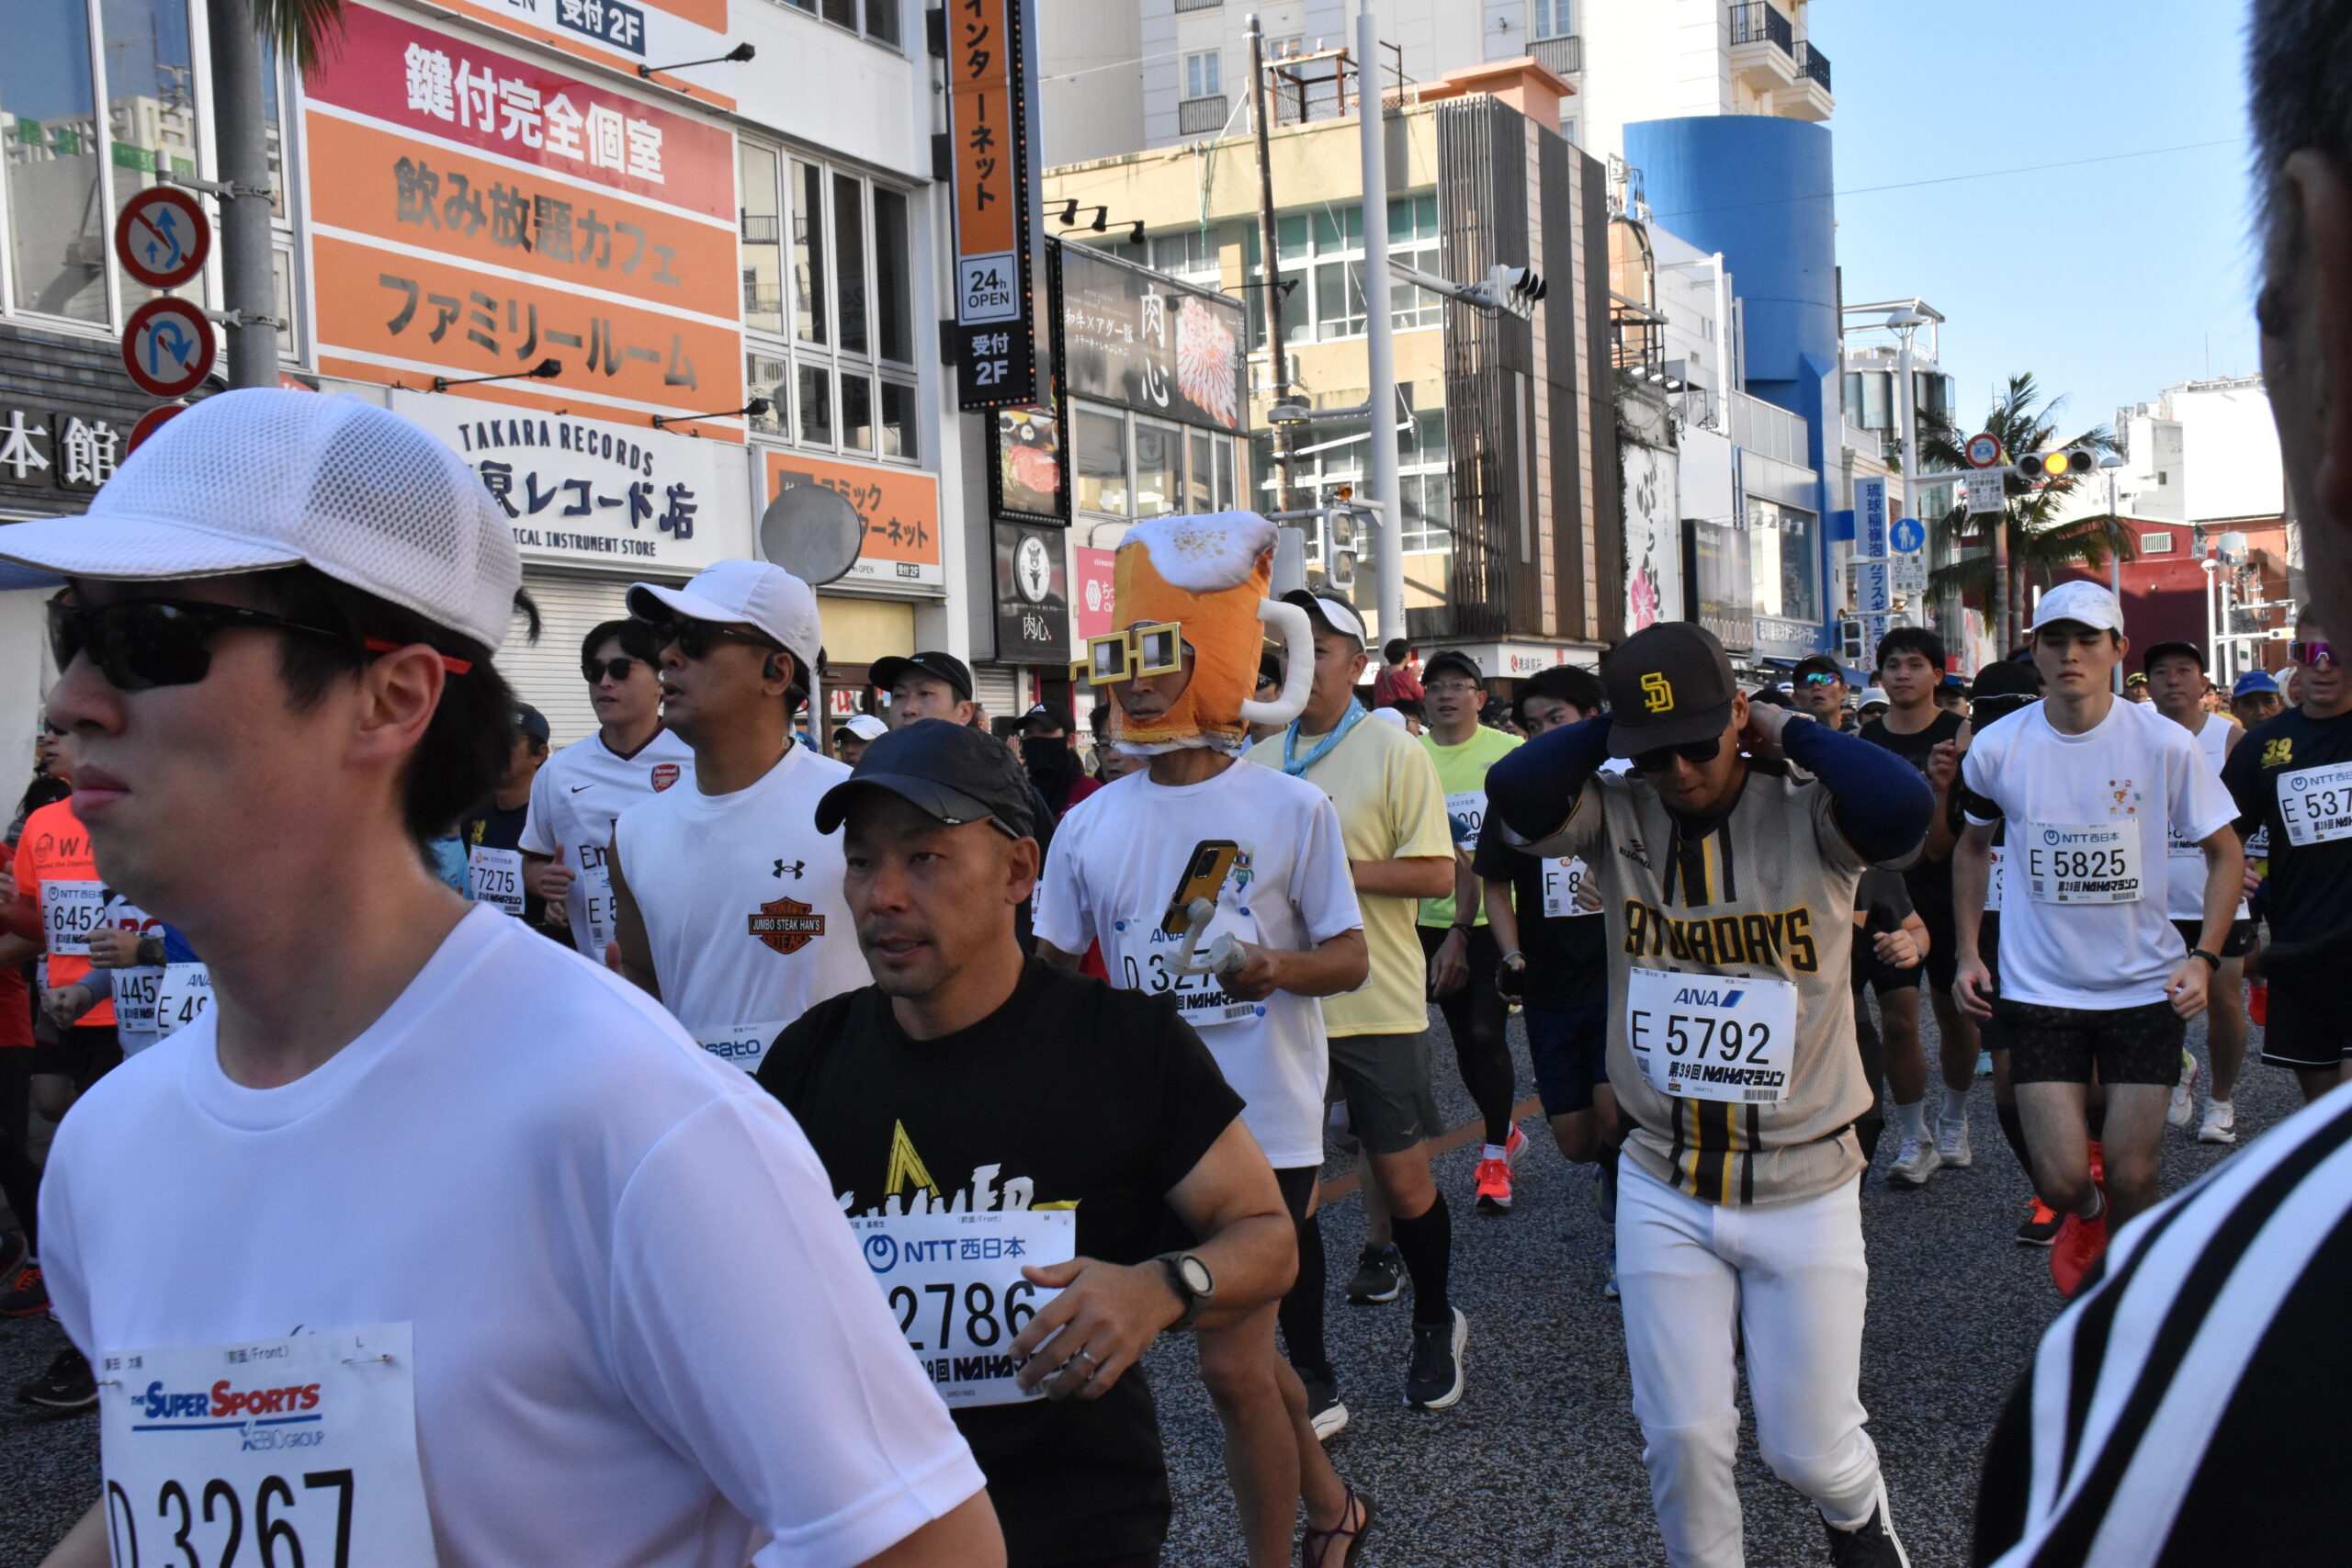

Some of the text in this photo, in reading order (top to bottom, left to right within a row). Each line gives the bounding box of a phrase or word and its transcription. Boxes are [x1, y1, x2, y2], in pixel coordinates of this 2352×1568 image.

[609, 8, 639, 46] 2F
[404, 42, 664, 185] 鍵付完全個室
[393, 155, 680, 287] 飲み放題カフェ
[968, 291, 1010, 308] OPEN
[379, 273, 698, 392] ファミリールーム
[971, 333, 1010, 356] 受付
[1140, 283, 1170, 408] 肉心
[976, 359, 1009, 386] 2F
[0, 410, 119, 485] 本館
[458, 418, 654, 478] TAKARA RECORDS
[514, 527, 656, 556] ICAL INSTRUMENT STORE
[859, 513, 929, 549] ターネット
[859, 565, 875, 574] OPEN
[910, 566, 919, 577] 2F
[1023, 613, 1049, 641] 肉心
[1640, 671, 1675, 714] SD
[2282, 798, 2299, 824] E
[2030, 848, 2126, 878] E 5825
[479, 868, 514, 893] 7275
[1545, 873, 1559, 896] F
[54, 906, 106, 931] 6452
[588, 897, 602, 924] E
[753, 919, 820, 931] JUMBO STEAK HAN'S
[1124, 955, 1140, 990] D
[121, 976, 164, 1005] 445
[1673, 987, 1719, 1008] ANA
[157, 996, 173, 1028] E
[706, 1039, 761, 1057] sato
[1632, 1010, 1771, 1066] E 5792
[905, 1236, 1026, 1264] NTT西日本
[888, 1280, 1036, 1350] 2786
[158, 1468, 354, 1568] 3267
